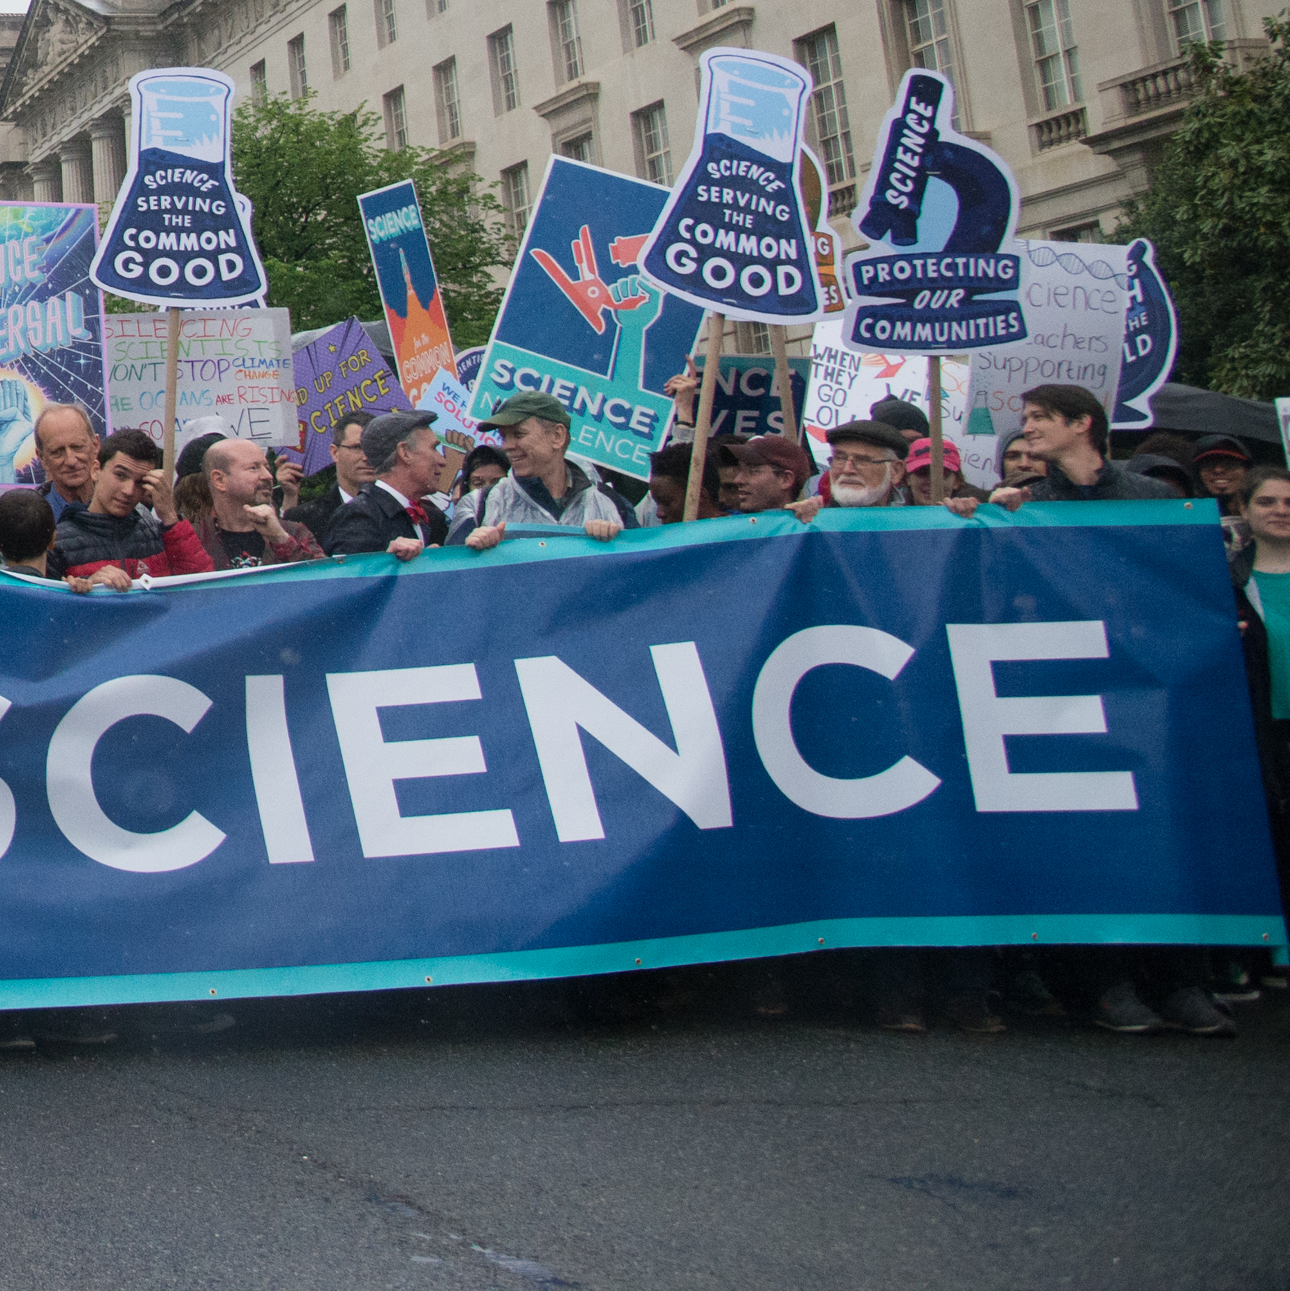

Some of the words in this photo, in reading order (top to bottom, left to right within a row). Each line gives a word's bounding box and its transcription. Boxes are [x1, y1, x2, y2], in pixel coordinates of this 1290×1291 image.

[885, 96, 934, 209] SCIENCE
[144, 168, 219, 192] SCIENCE
[707, 159, 786, 193] SCIENCE
[137, 196, 226, 215] SERVING
[697, 185, 791, 221] SERVING
[163, 214, 192, 227] THE
[367, 205, 419, 241] SCIENCE
[723, 209, 754, 229] THE
[123, 228, 237, 251] COMMON
[678, 217, 798, 260] COMMON
[114, 250, 244, 286] GOOD
[665, 242, 803, 297] GOOD
[861, 258, 1015, 285] PROTECTING
[913, 288, 965, 309] OUR
[1026, 282, 1119, 314] cience
[859, 312, 1020, 343] COMMUNITIES
[1025, 323, 1108, 353] achers
[232, 358, 291, 369] CLIMATE
[314, 371, 333, 394] UP
[339, 349, 373, 379] FOR
[403, 342, 451, 383] COMMON
[813, 344, 861, 372] WHEN
[978, 352, 1107, 389] Supporting
[234, 369, 279, 381] CHANGE
[812, 361, 858, 390] THEY
[139, 390, 213, 409] OCANS
[215, 394, 235, 406] ARE
[237, 386, 296, 403] RISING
[442, 382, 460, 403] WE
[490, 358, 658, 436] SCIENCE
[817, 383, 847, 407] GO
[434, 391, 497, 445] SOLUTIO
[571, 424, 651, 465] ENCE
